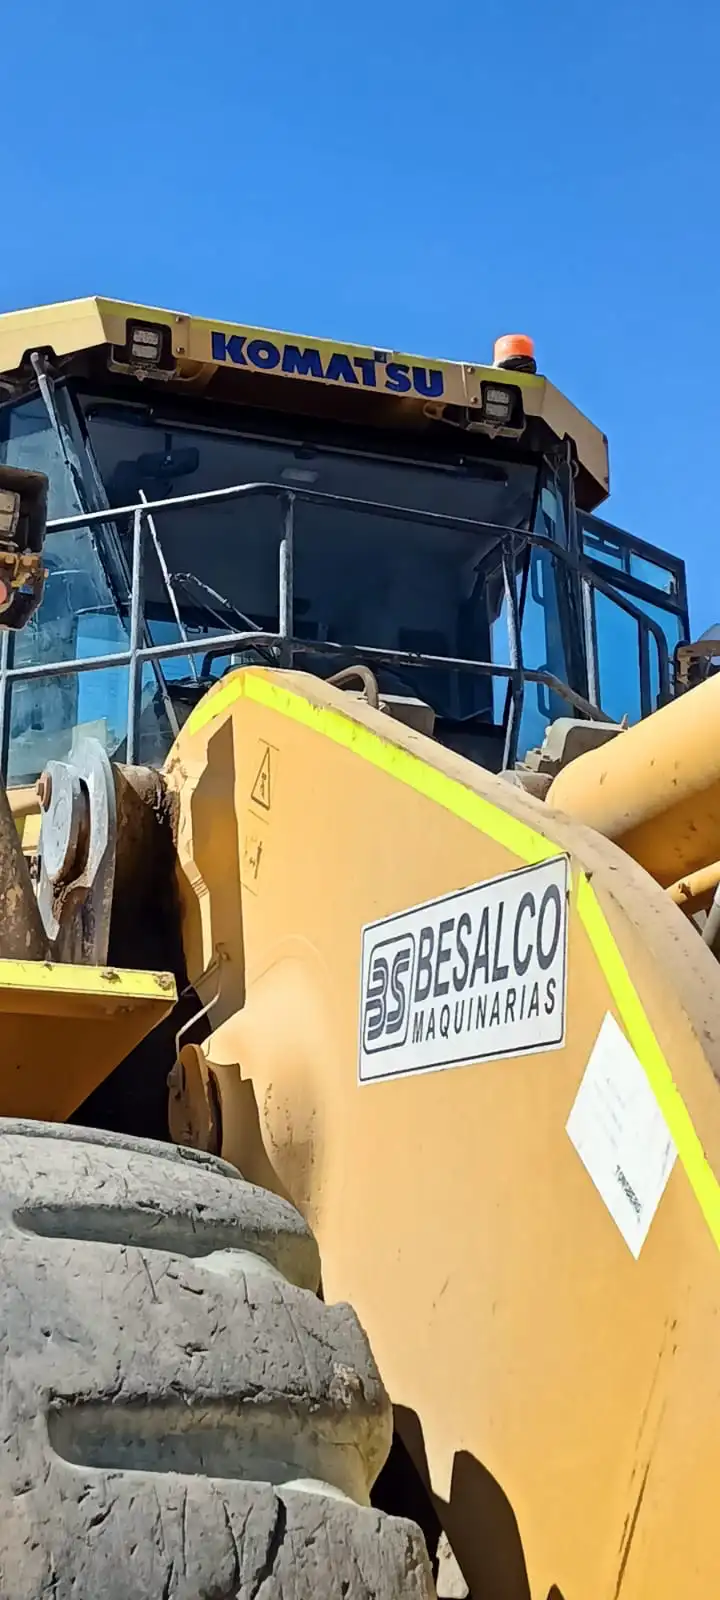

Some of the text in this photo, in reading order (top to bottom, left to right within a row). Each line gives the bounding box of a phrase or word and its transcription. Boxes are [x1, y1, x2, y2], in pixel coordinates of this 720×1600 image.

[211, 332, 444, 397] KOMATSU
[414, 884, 562, 1003] BESALCO
[412, 978, 556, 1044] MAQUINARIAS
